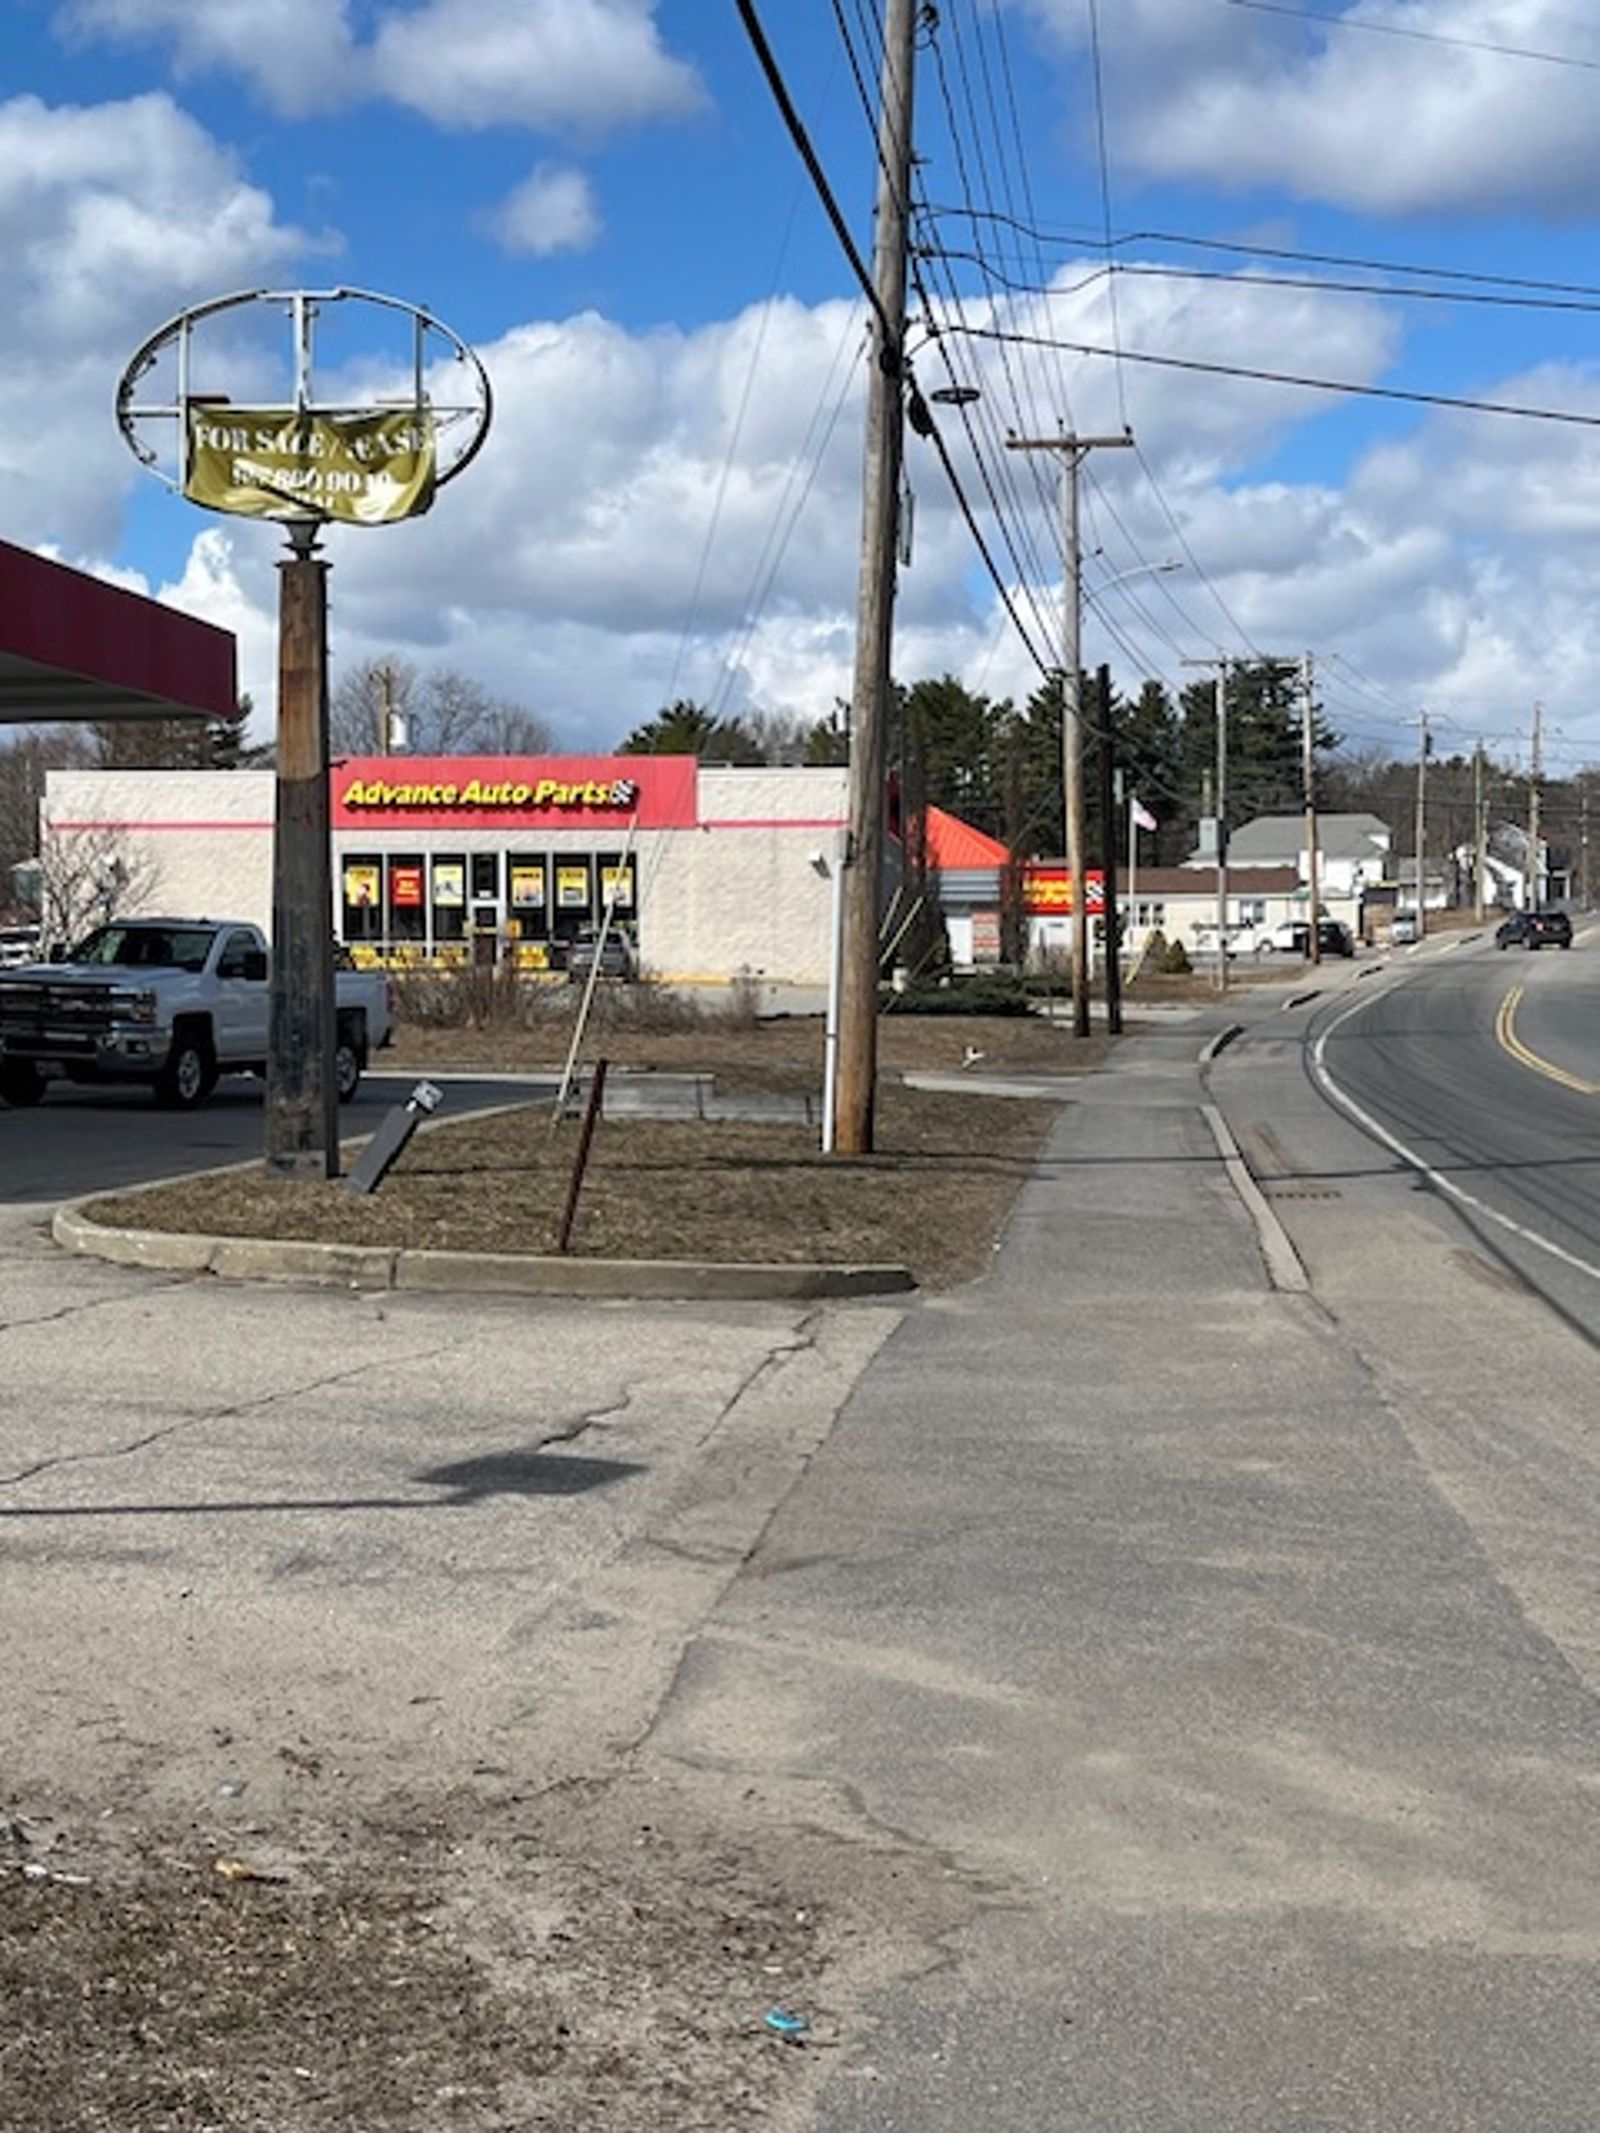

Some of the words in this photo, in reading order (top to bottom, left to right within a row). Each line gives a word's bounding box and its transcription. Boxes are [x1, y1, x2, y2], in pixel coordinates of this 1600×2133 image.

[195, 425, 249, 453] FOR
[256, 428, 326, 458] SALE
[343, 779, 456, 804] Advance
[459, 779, 530, 804] Auto
[532, 779, 607, 804] Parts
